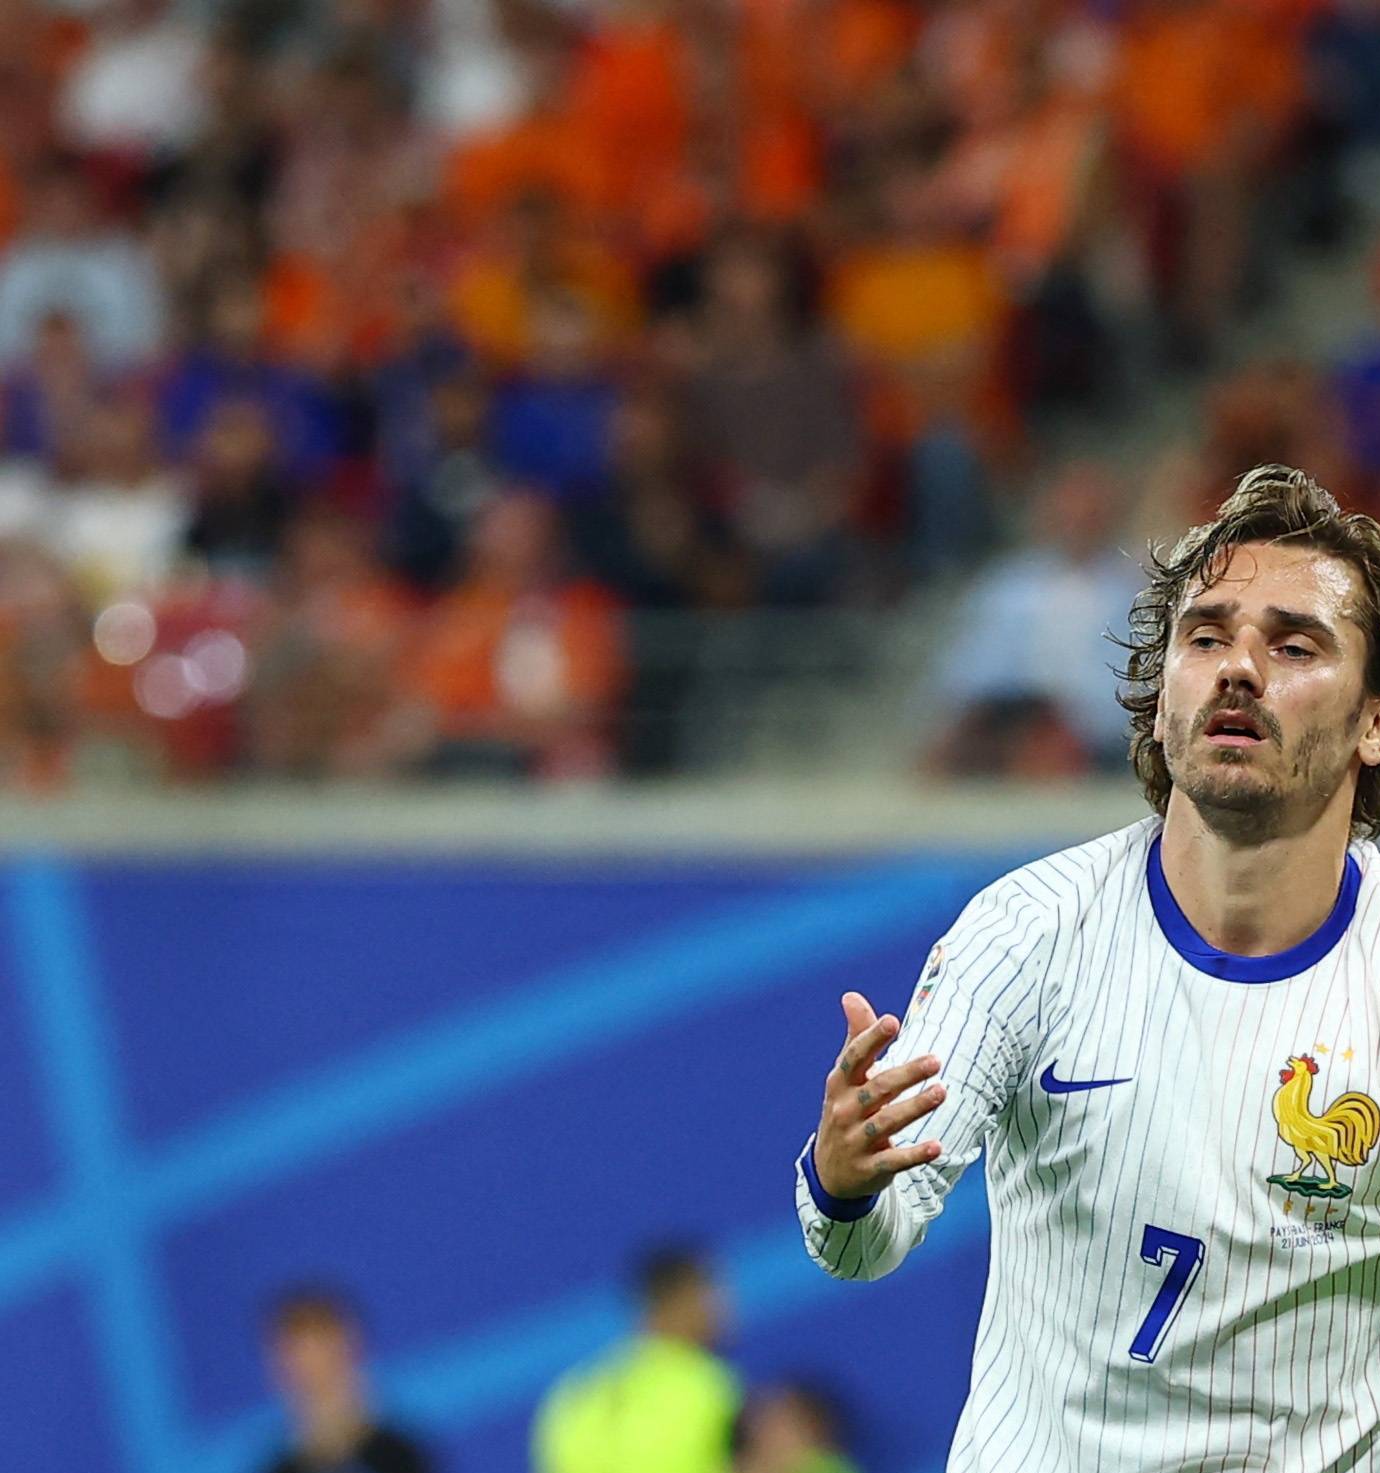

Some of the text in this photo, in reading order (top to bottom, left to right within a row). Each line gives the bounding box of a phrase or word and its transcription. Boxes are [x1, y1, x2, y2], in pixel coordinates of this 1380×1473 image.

[1313, 1219, 1345, 1232] FRANCE
[1281, 1238, 1292, 1249] 21
[1128, 1224, 1206, 1364] 7
